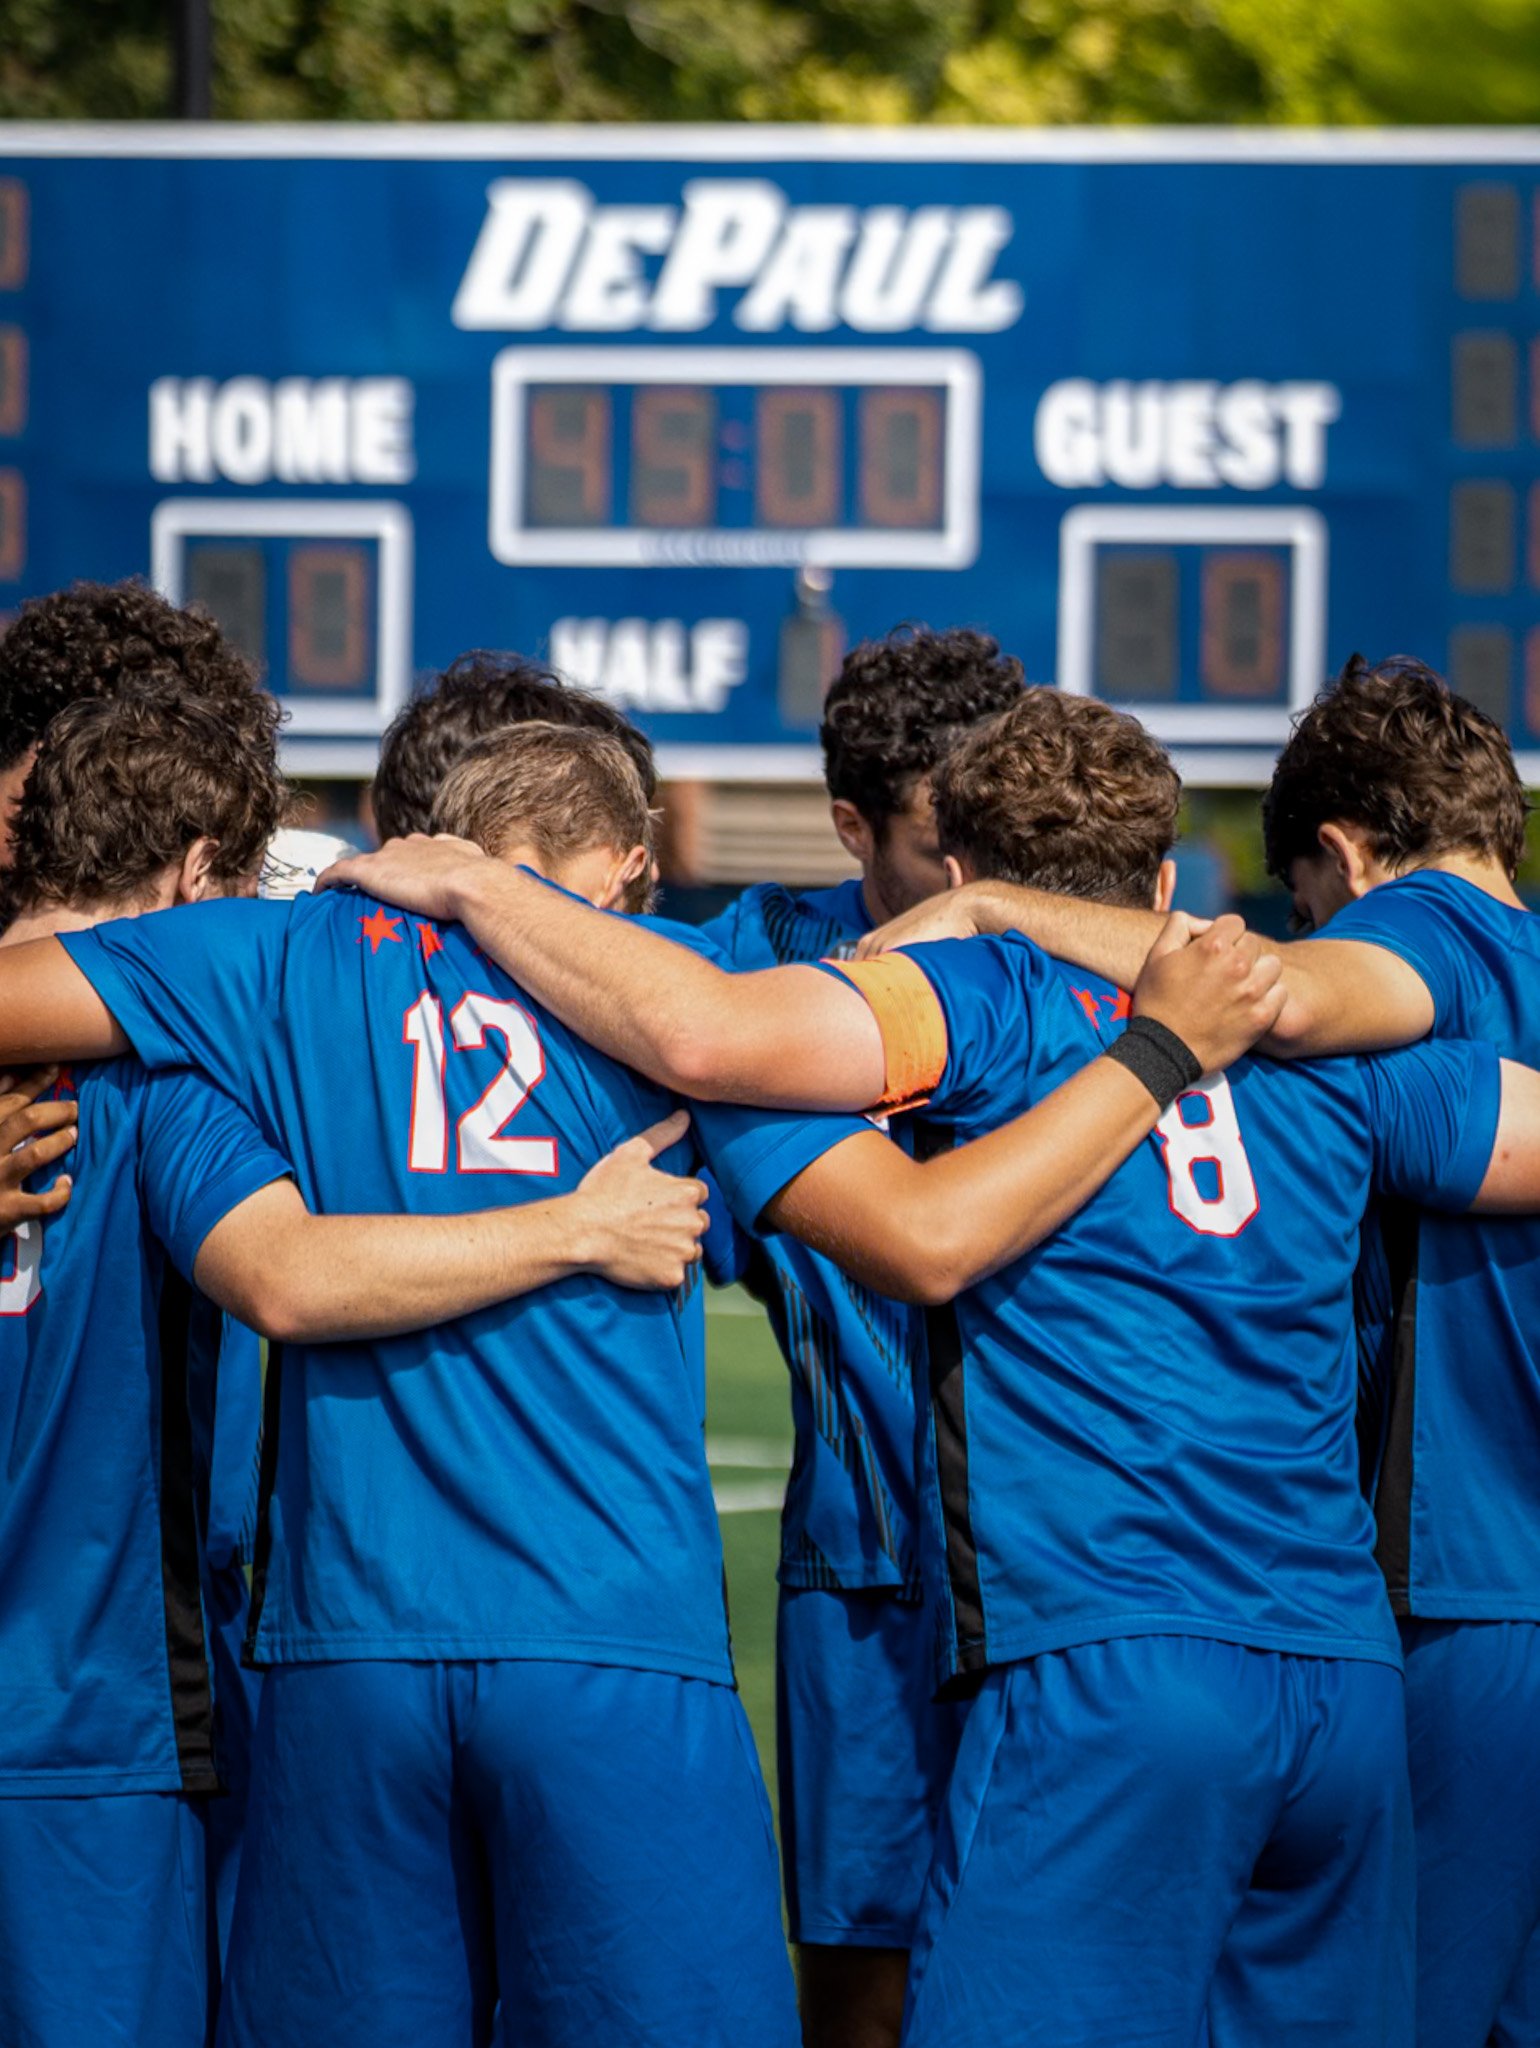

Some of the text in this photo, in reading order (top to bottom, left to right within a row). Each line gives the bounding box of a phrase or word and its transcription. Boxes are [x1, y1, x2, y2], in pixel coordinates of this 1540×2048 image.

[149, 376, 415, 483] HOME
[529, 386, 942, 528] 45:00
[1035, 380, 1341, 488] GUEST
[550, 617, 748, 713] HALF
[403, 990, 558, 1177] 12
[1156, 1072, 1259, 1237] 8
